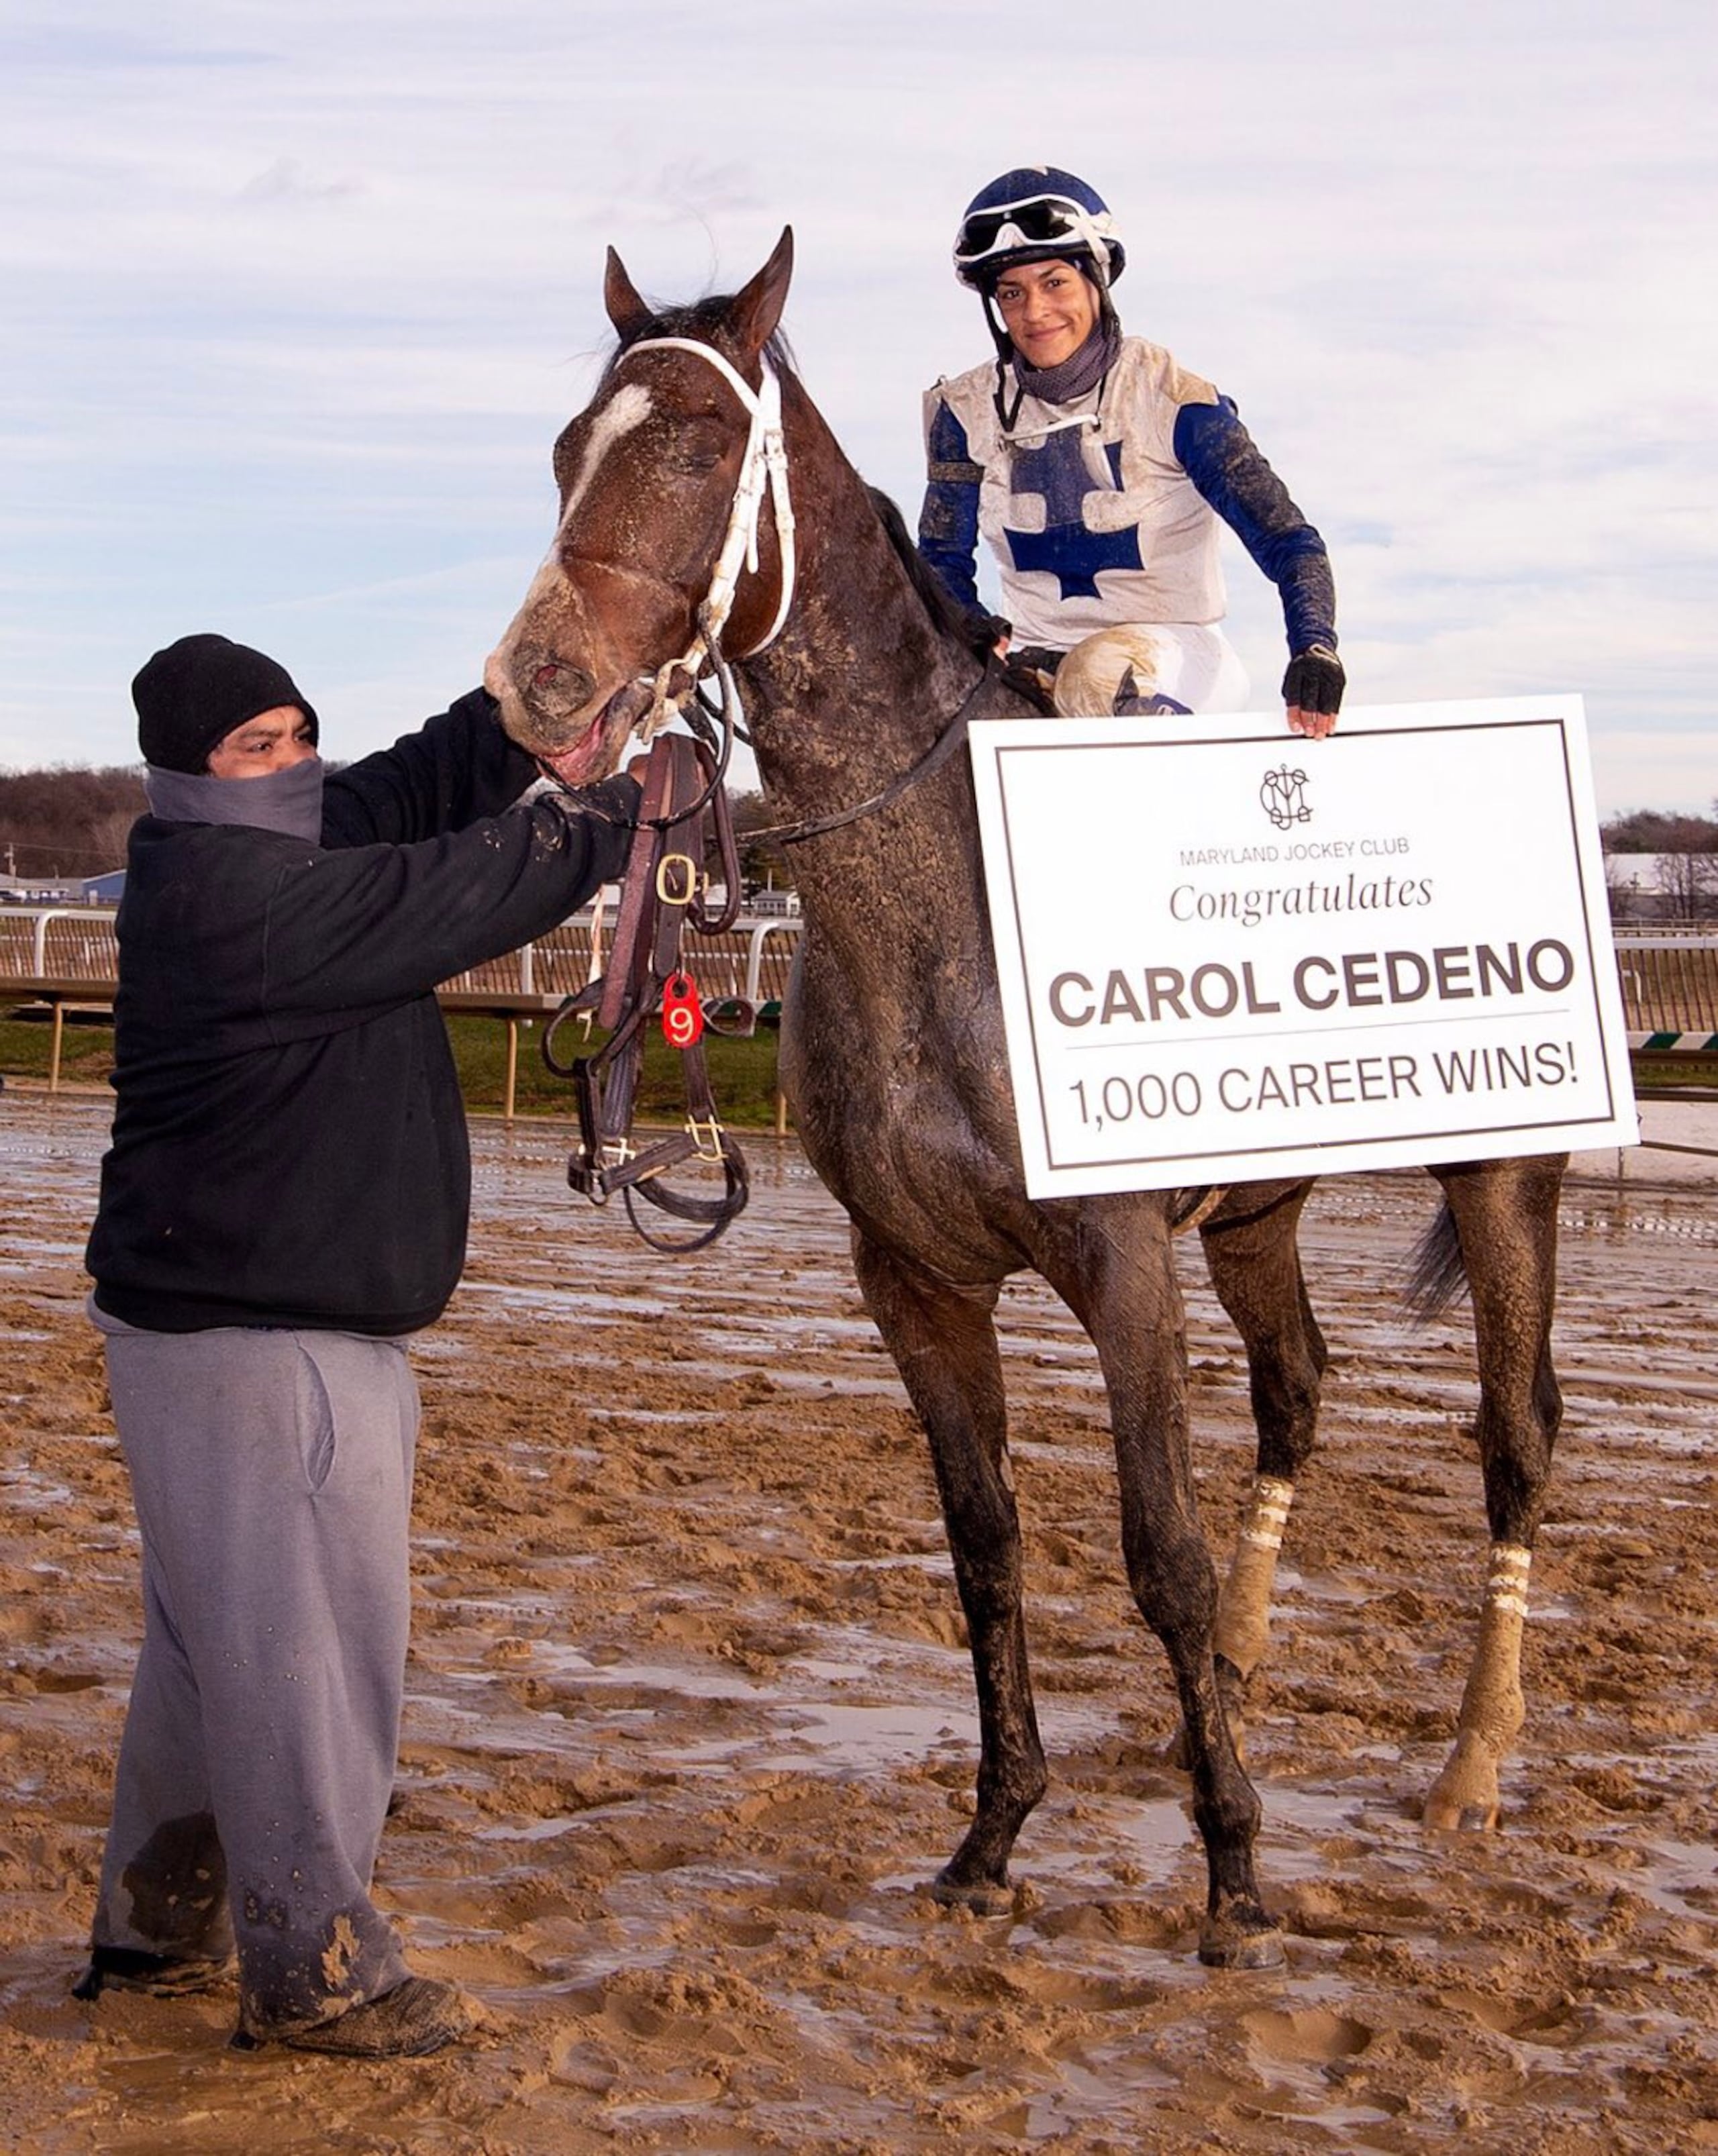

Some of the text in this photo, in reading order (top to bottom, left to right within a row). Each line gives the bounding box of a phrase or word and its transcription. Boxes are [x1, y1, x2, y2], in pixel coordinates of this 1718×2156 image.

[1179, 837, 1410, 866] MARYLAND JOCKEY CLUB
[1170, 872, 1433, 927] Congratulates
[1049, 939, 1575, 1027] CAROL CEDENO
[670, 1007, 693, 1043] 9
[1069, 1041, 1578, 1132] 1,000 CAREER WINS!
